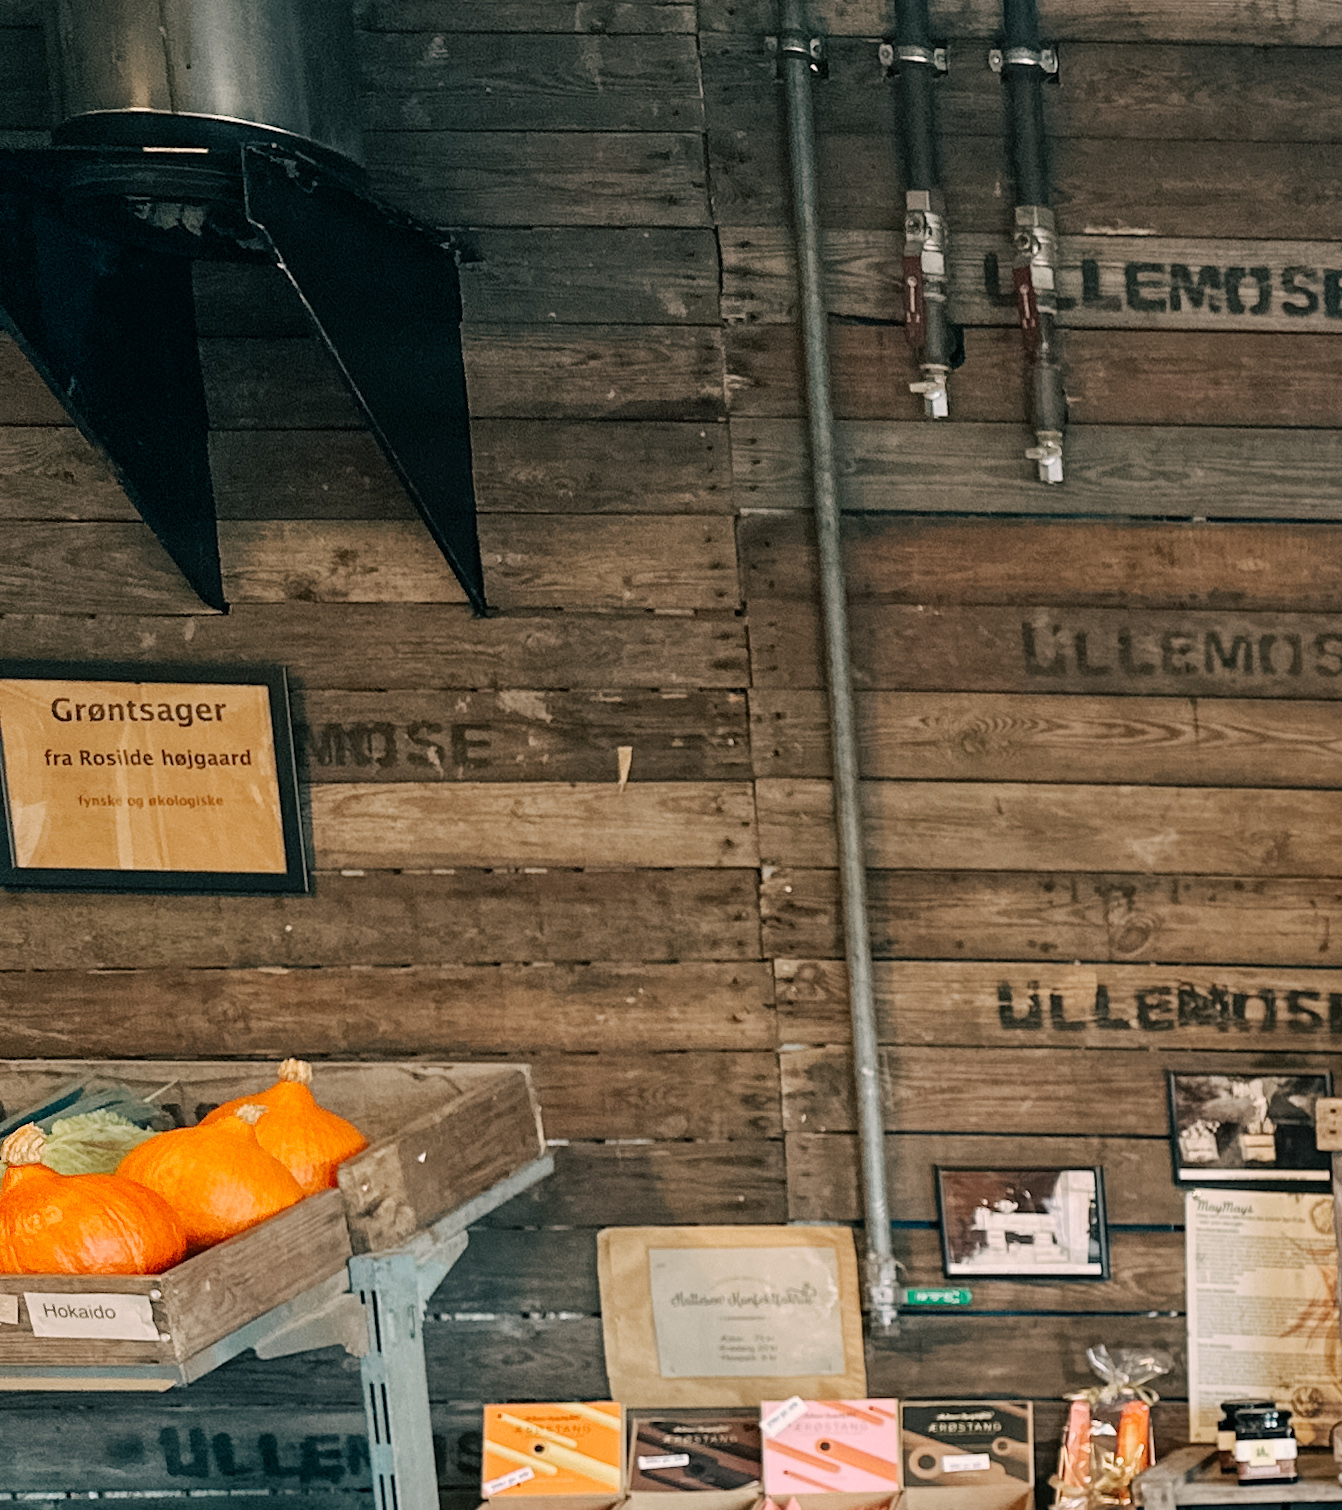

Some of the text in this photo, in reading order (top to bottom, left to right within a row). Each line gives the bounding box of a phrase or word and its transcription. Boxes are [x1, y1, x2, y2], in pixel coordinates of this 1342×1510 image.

[50, 697, 227, 728] Grøntsager
[44, 748, 252, 771] fra Rosilde højgaard
[77, 793, 224, 809] fynske og økologiske
[42, 1302, 117, 1320] Hokaido
